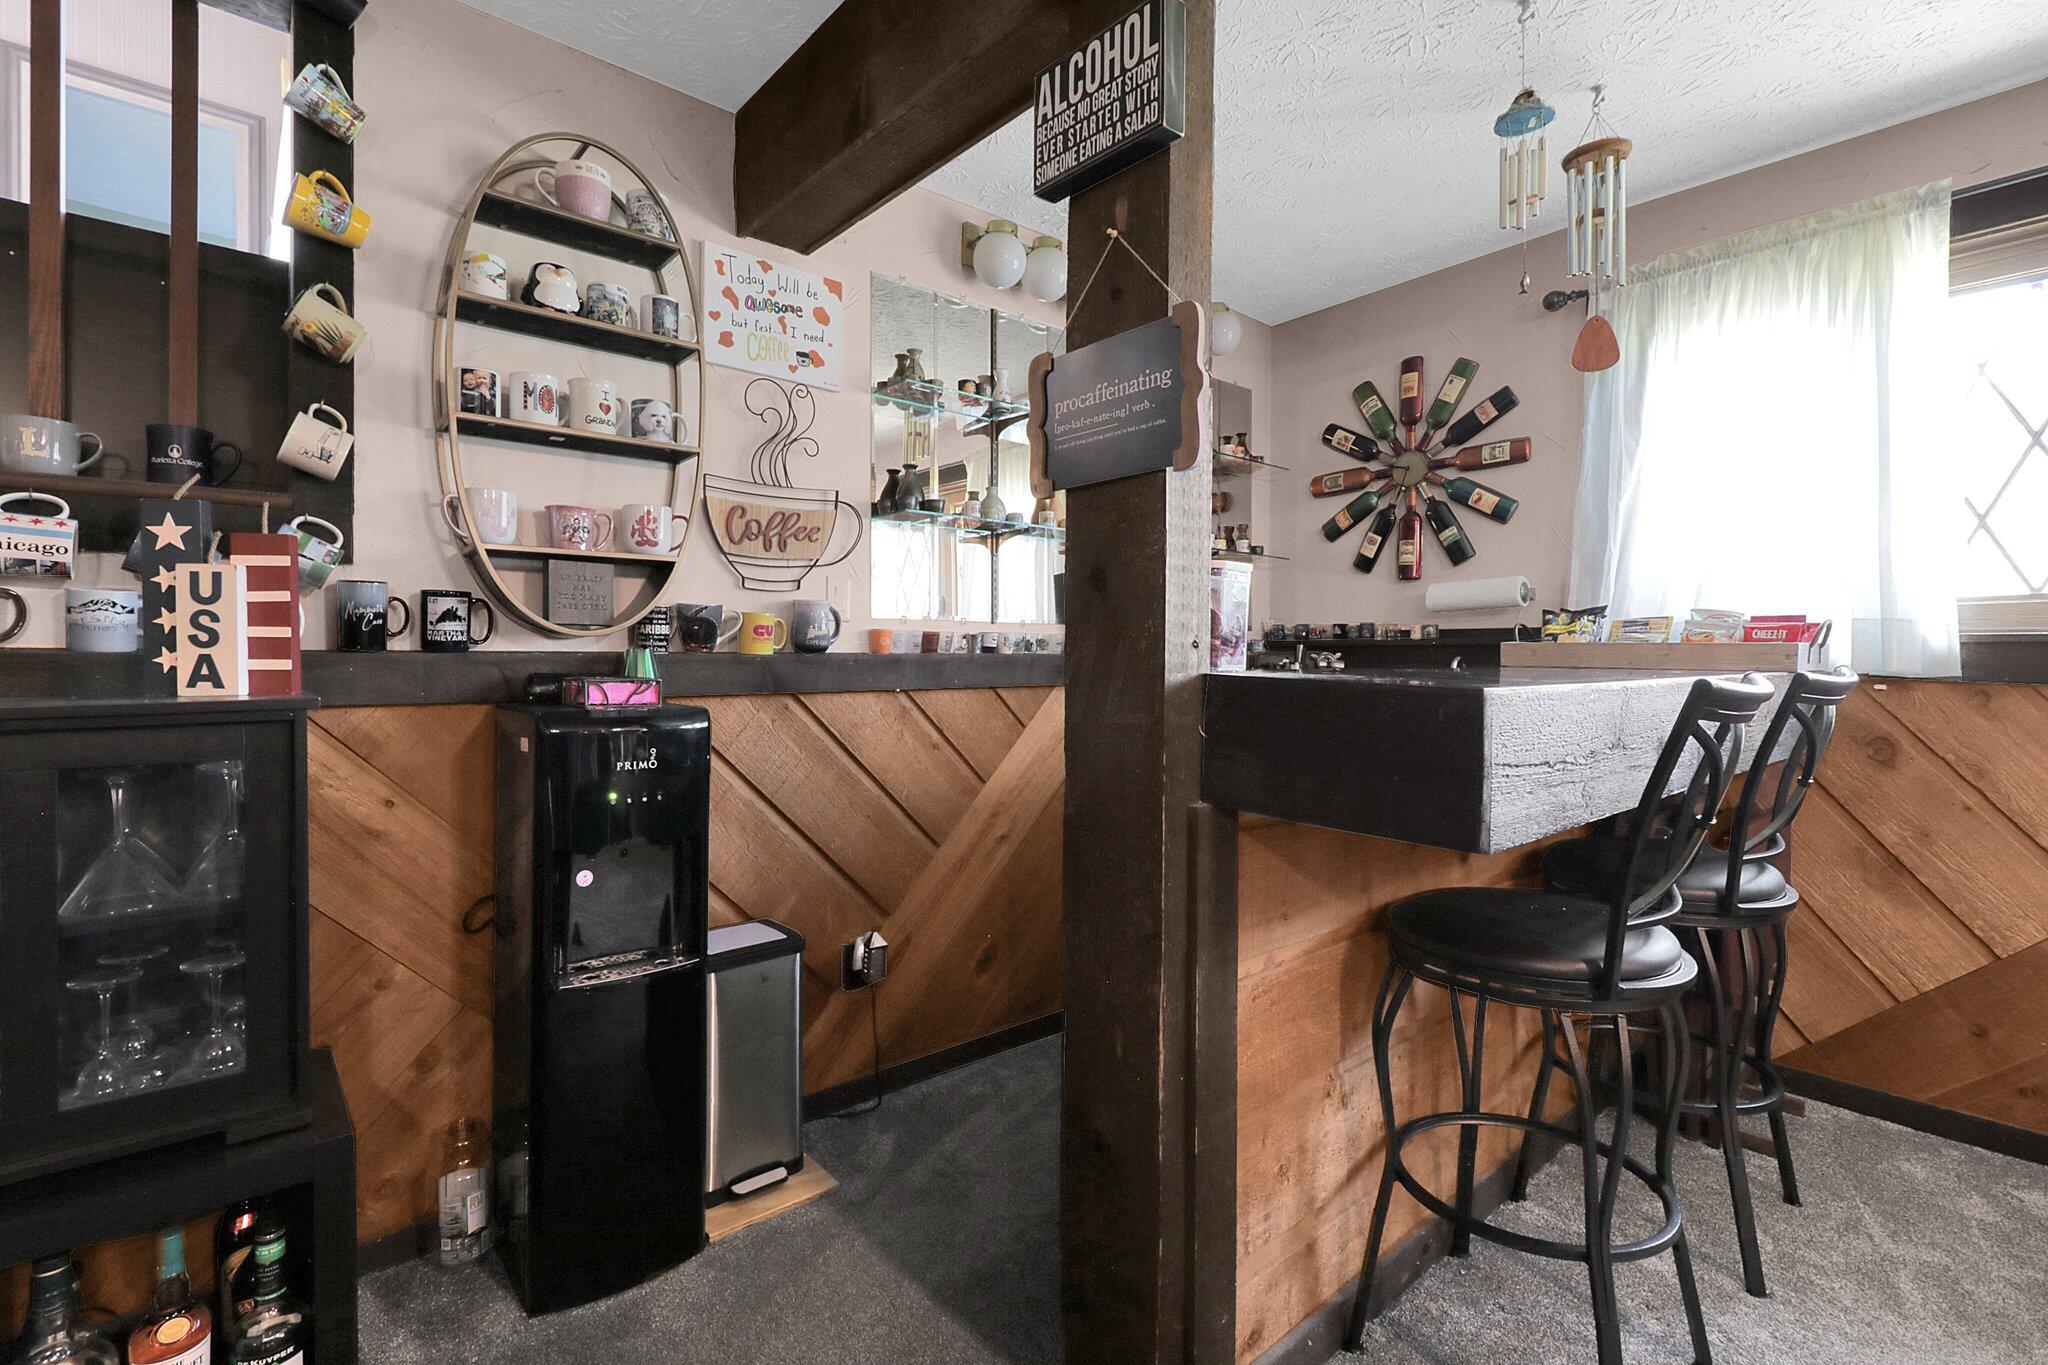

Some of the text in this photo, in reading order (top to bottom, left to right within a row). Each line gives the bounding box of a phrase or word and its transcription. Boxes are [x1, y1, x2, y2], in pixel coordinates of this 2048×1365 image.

[1037, 3, 1159, 126] ALCOHOL
[1036, 54, 1159, 146] BECAUSE NO GREAT STORY
[1036, 77, 1159, 166] EVER STARTED WITH
[1036, 101, 1158, 186] SOMEONE EATING A SALAD
[721, 253, 765, 294] Today
[806, 283, 819, 300] be
[745, 295, 803, 318] awesome
[731, 313, 748, 328] but
[791, 326, 797, 339] I
[803, 330, 824, 342] need
[523, 381, 558, 418] MO
[601, 390, 609, 402] I
[1054, 368, 1173, 419] procaffeinating
[20, 427, 50, 458] L
[0, 536, 69, 557] icago
[726, 505, 821, 552] Coffee
[185, 570, 226, 690] USA
[1752, 629, 1788, 639] CHEEZ-IT
[616, 759, 658, 771] PRIMO
[249, 1344, 296, 1365] KUYPER
